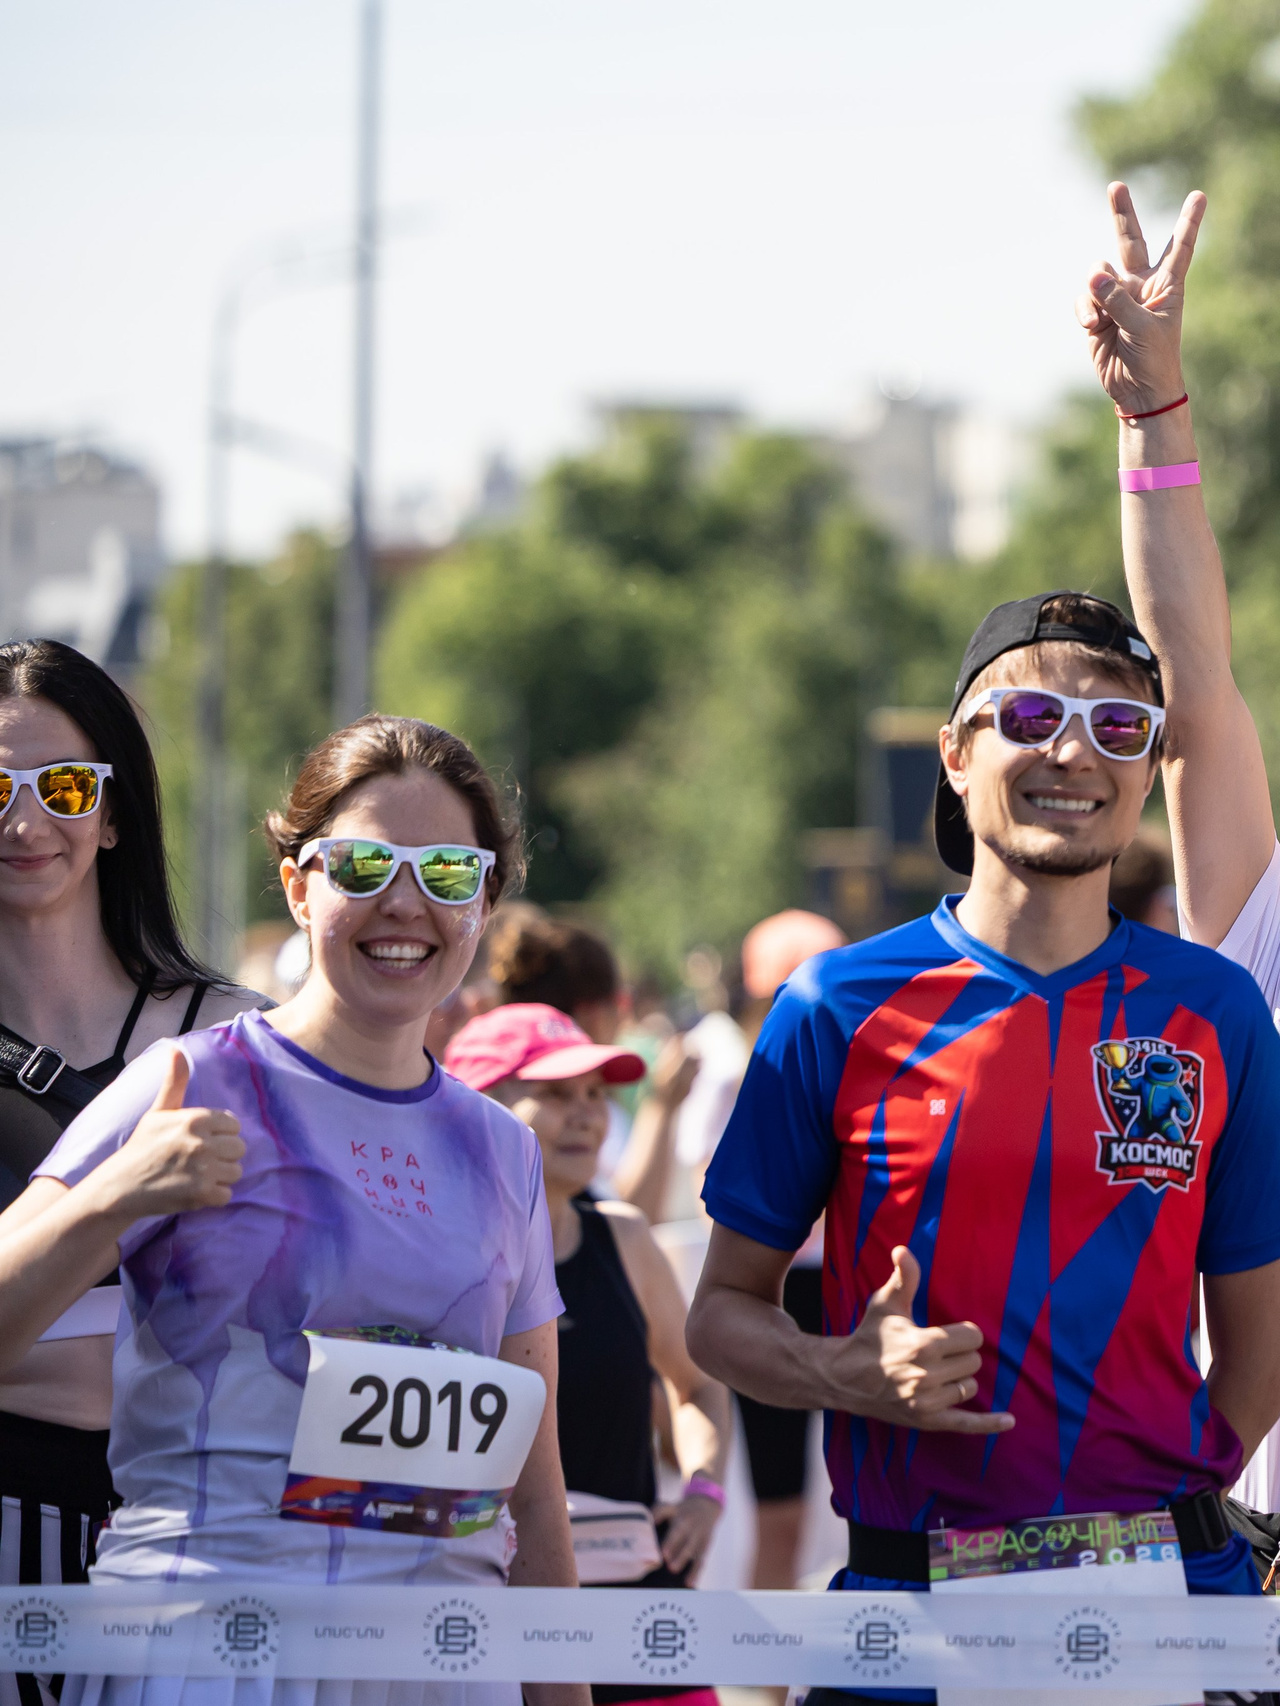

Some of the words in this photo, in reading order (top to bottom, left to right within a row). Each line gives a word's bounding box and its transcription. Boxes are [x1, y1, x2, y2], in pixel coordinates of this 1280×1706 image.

[1110, 1142, 1193, 1171] КОСМОС
[340, 1375, 508, 1454] 2019
[952, 1516, 1160, 1562] КРАСОЧНЫЙ
[954, 1555, 1065, 1575] ЗАБЕГ
